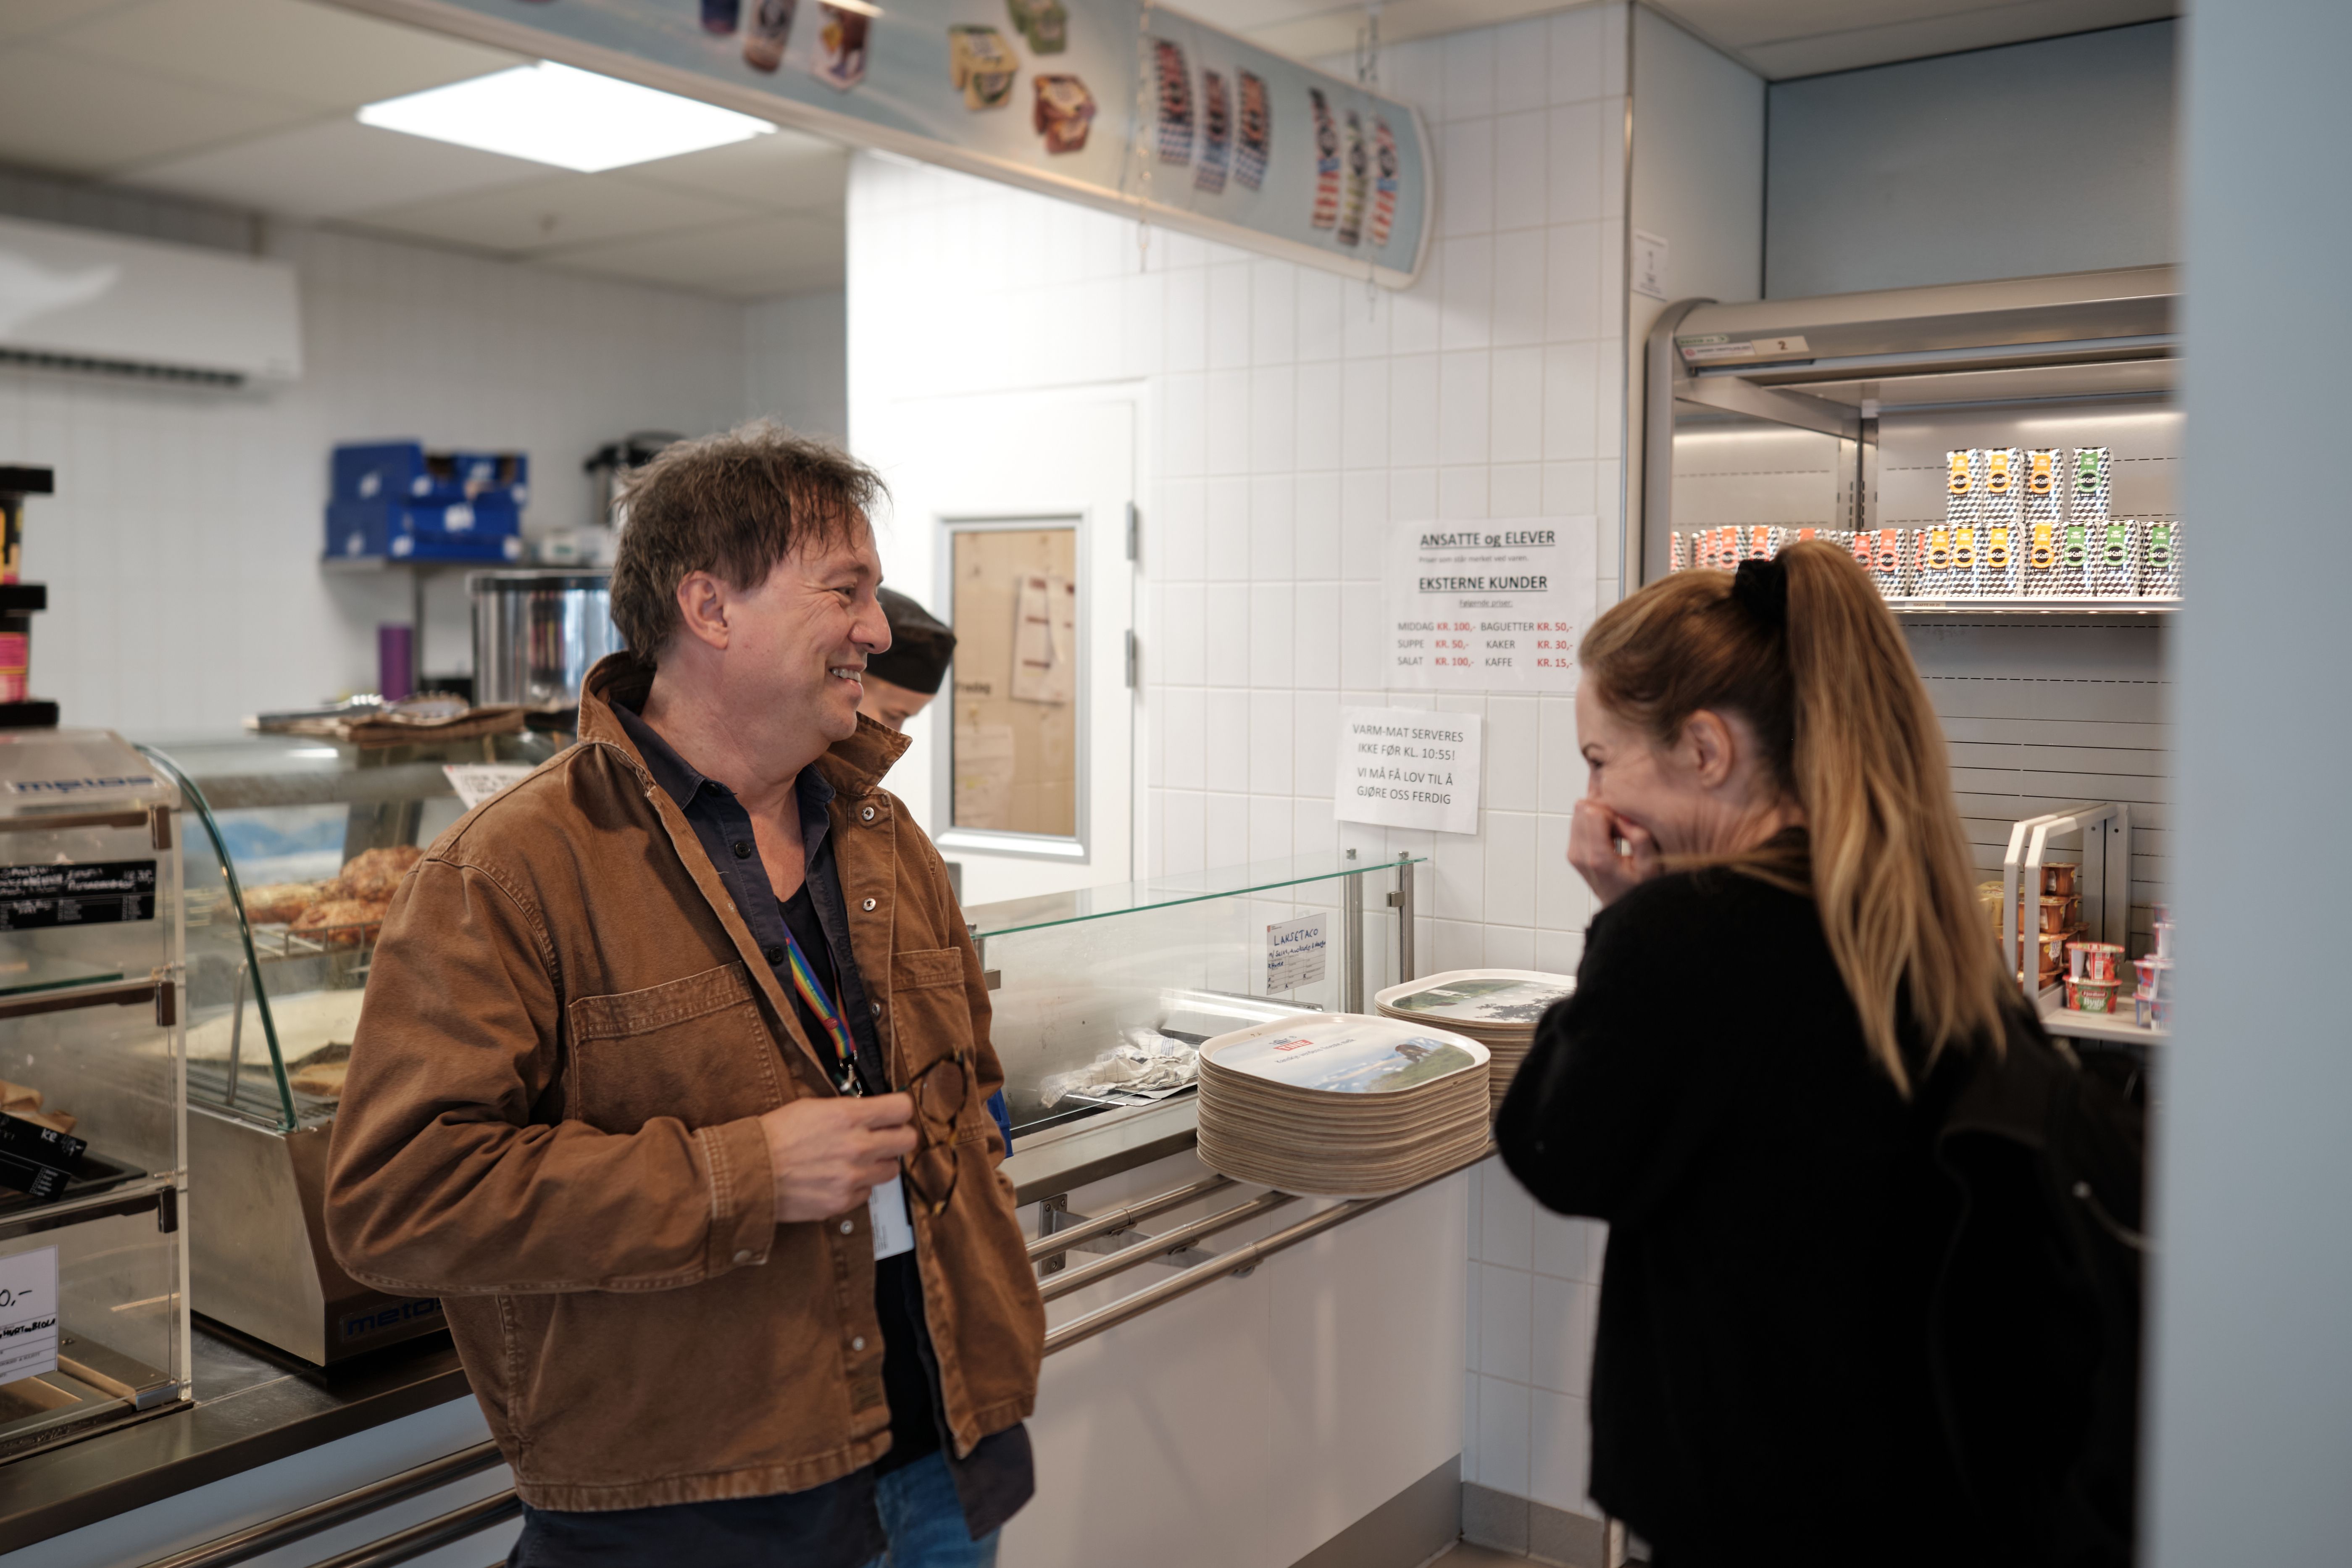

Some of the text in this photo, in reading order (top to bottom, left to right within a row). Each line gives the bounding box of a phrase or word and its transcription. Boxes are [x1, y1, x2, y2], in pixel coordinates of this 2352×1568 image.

[1421, 531, 1555, 547] ANSATTE og ELEVER
[1419, 576, 1547, 589] EKSTERNE KUNDER
[1454, 623, 1476, 632] 100,-
[1555, 623, 1573, 632] 50,-
[1452, 640, 1469, 650] 50,-
[1486, 640, 1515, 649] KAKER
[1555, 641, 1573, 650] 30,-
[1452, 658, 1474, 667] 100,-
[1486, 658, 1512, 667] KAFFE
[1556, 659, 1573, 668] 15,-
[1352, 724, 1463, 742] VARM-MAT SERVERES
[1358, 743, 1455, 760] IKKE FØR KL. 10:55!
[1358, 767, 1453, 785] VI MÅ FÅ LOV TIL Å
[1357, 786, 1451, 804] GJØRE OSS FERDIG
[1274, 929, 1318, 946] LAKSETACO
[1278, 1040, 1310, 1050] TINE
[32, 1318, 56, 1330] BIOLA
